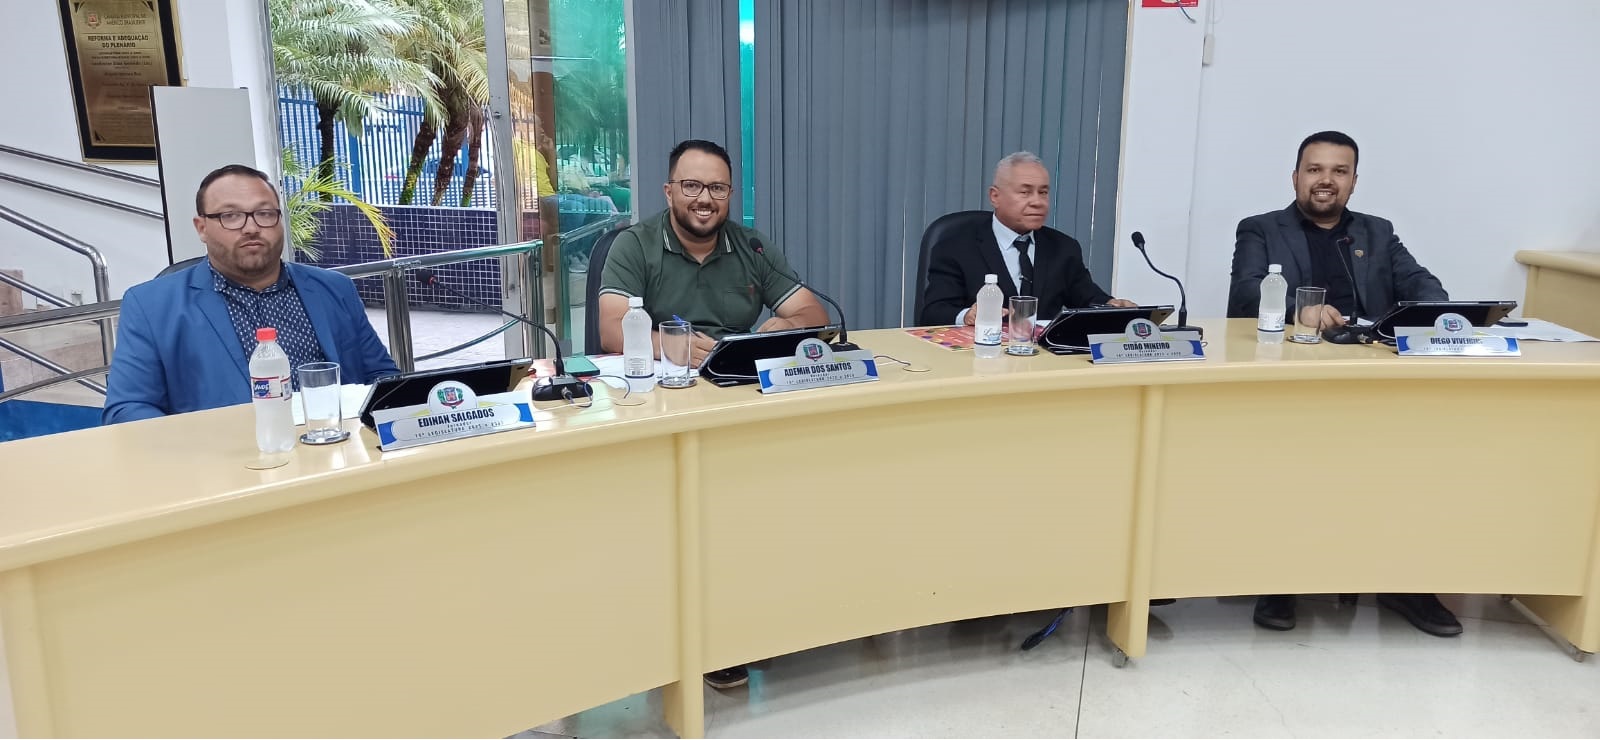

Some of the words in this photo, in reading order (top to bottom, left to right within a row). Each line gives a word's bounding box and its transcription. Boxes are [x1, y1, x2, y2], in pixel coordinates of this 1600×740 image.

[1143, 342, 1170, 350] MINEIRO
[1430, 337, 1451, 345] DIEGO
[784, 367, 811, 377] ADEMIR
[811, 365, 825, 374] DOS
[826, 362, 852, 372] SANTOS
[418, 415, 450, 428] EDINAN
[450, 408, 495, 423] SALGADOS
